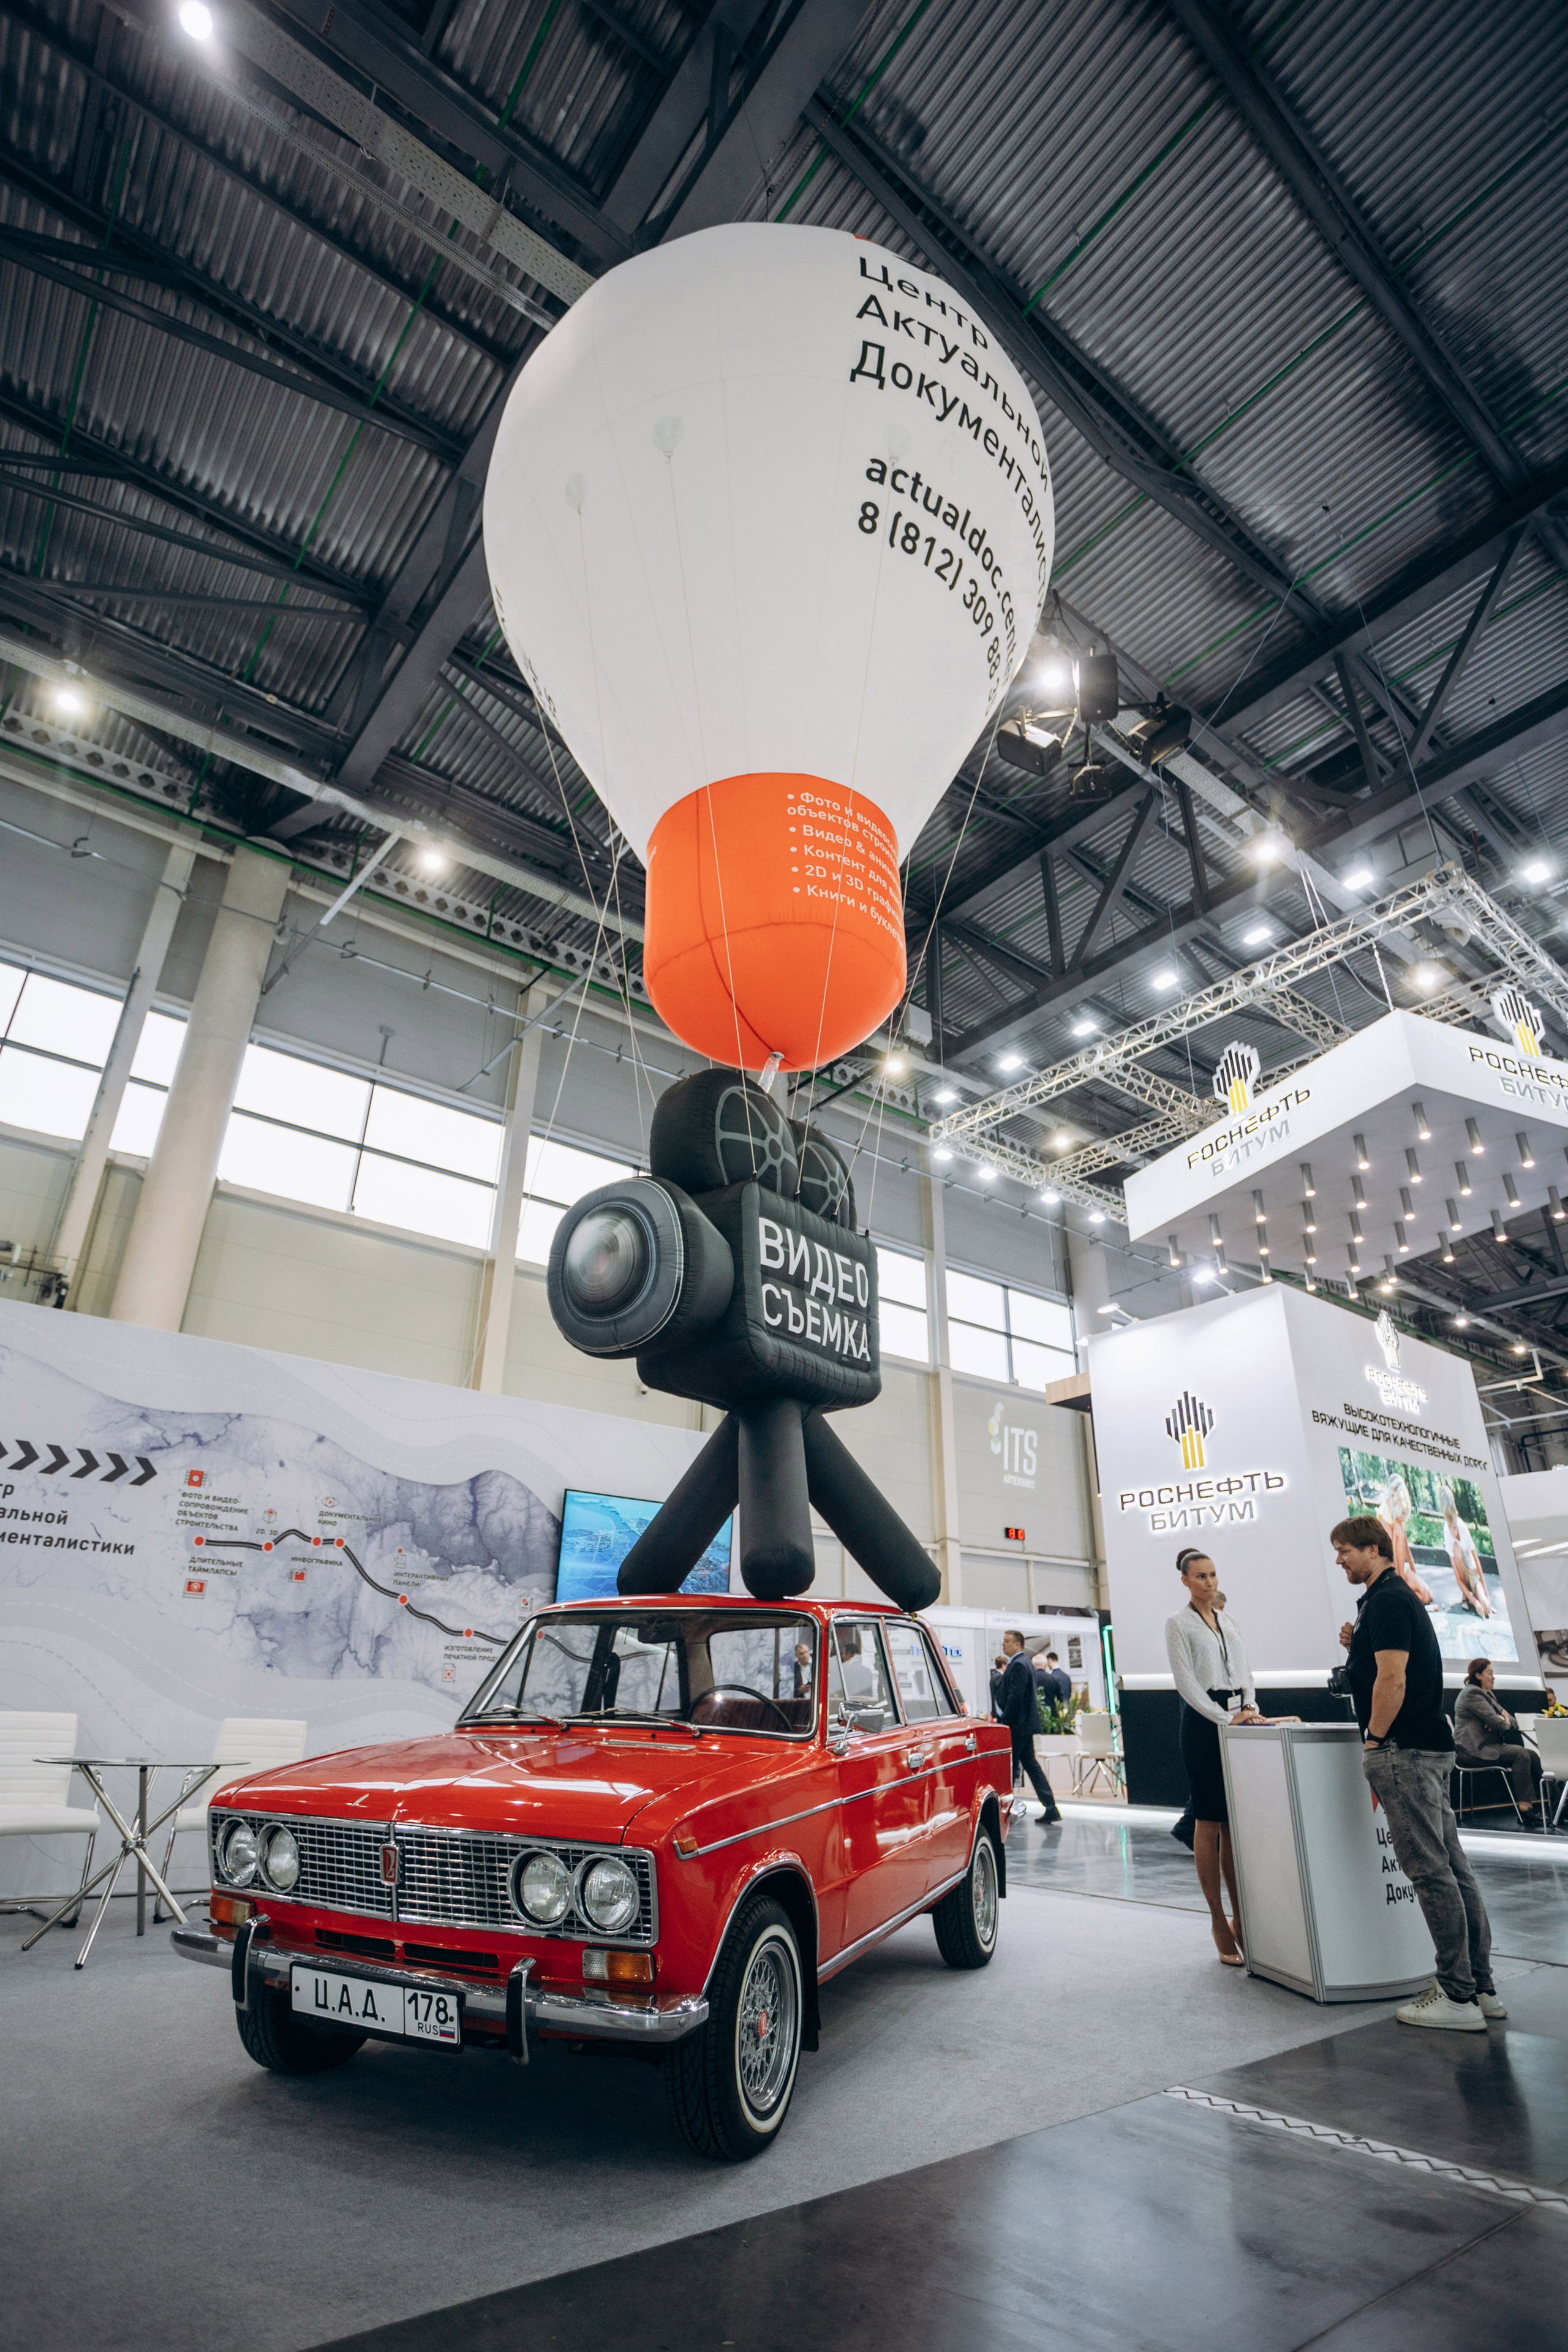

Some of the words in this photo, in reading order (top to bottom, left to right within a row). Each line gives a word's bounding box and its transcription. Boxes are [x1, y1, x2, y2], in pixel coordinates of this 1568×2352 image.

[859, 257, 988, 349] Центр
[856, 294, 1047, 493] Актуальной
[858, 502, 880, 534] 8
[889, 511, 963, 591] (812)
[963, 578, 993, 638] 309
[987, 636, 1001, 680] 88
[787, 805, 859, 832] объектов
[800, 792, 840, 811] Фото
[845, 805, 853, 816] и
[802, 824, 852, 847] Видео
[856, 841, 865, 855] &
[804, 844, 866, 872] Контент
[869, 869, 888, 890] для
[805, 864, 827, 878] 2D
[832, 872, 841, 882] и
[845, 873, 864, 891] 3D
[807, 884, 855, 908] Книги
[859, 902, 867, 913] и
[870, 906, 903, 949] буклеты
[1187, 1089, 1311, 1170] РОСНЕФТЬ
[1211, 1119, 1290, 1177] БИТУМ
[758, 1216, 869, 1308] ВИДЕО
[761, 1283, 872, 1362] СЪЕМКА
[1311, 1409, 1370, 1437] ВЯЖУЩИЕ
[1371, 1428, 1392, 1444] ДЛЯ
[1392, 1434, 1463, 1464] КАЧЕСТВЕННЫХ
[1343, 1403, 1461, 1450] ВЫСОКОТЕХНОЛОГИЧНЫЕ
[1003, 1426, 1038, 1476] ITS
[181, 1491, 203, 1500] ФОТО
[1120, 1471, 1284, 1510] РОСНЕФТЬ
[176, 1509, 218, 1520] ОБЪЕКТОВ
[179, 1501, 249, 1515] СОПРОВОЖДЕНИЕ
[318, 1510, 383, 1524] ДОКУМЕНТАЛЬНОЕ
[1150, 1500, 1254, 1531] БИТУМ
[175, 1519, 239, 1531] СТРОИТЕЛЬСТВА
[187, 1565, 238, 1576] ТАЙМЛАПСЫ
[189, 1556, 244, 1567] ДЛИТЕЛЬНЫЕ
[291, 1556, 343, 1566] ИНФОГРАФИКА
[394, 1572, 450, 1582] ИНТЕРАКТИВНЫЕ
[444, 1645, 494, 1654] ИЗГОТОВЛЕНИЕ
[1386, 1883, 1416, 1905] Доку
[315, 1978, 386, 2022] Ц.А.Д.
[407, 1992, 448, 2025] 178
[418, 2022, 439, 2035] RUS
